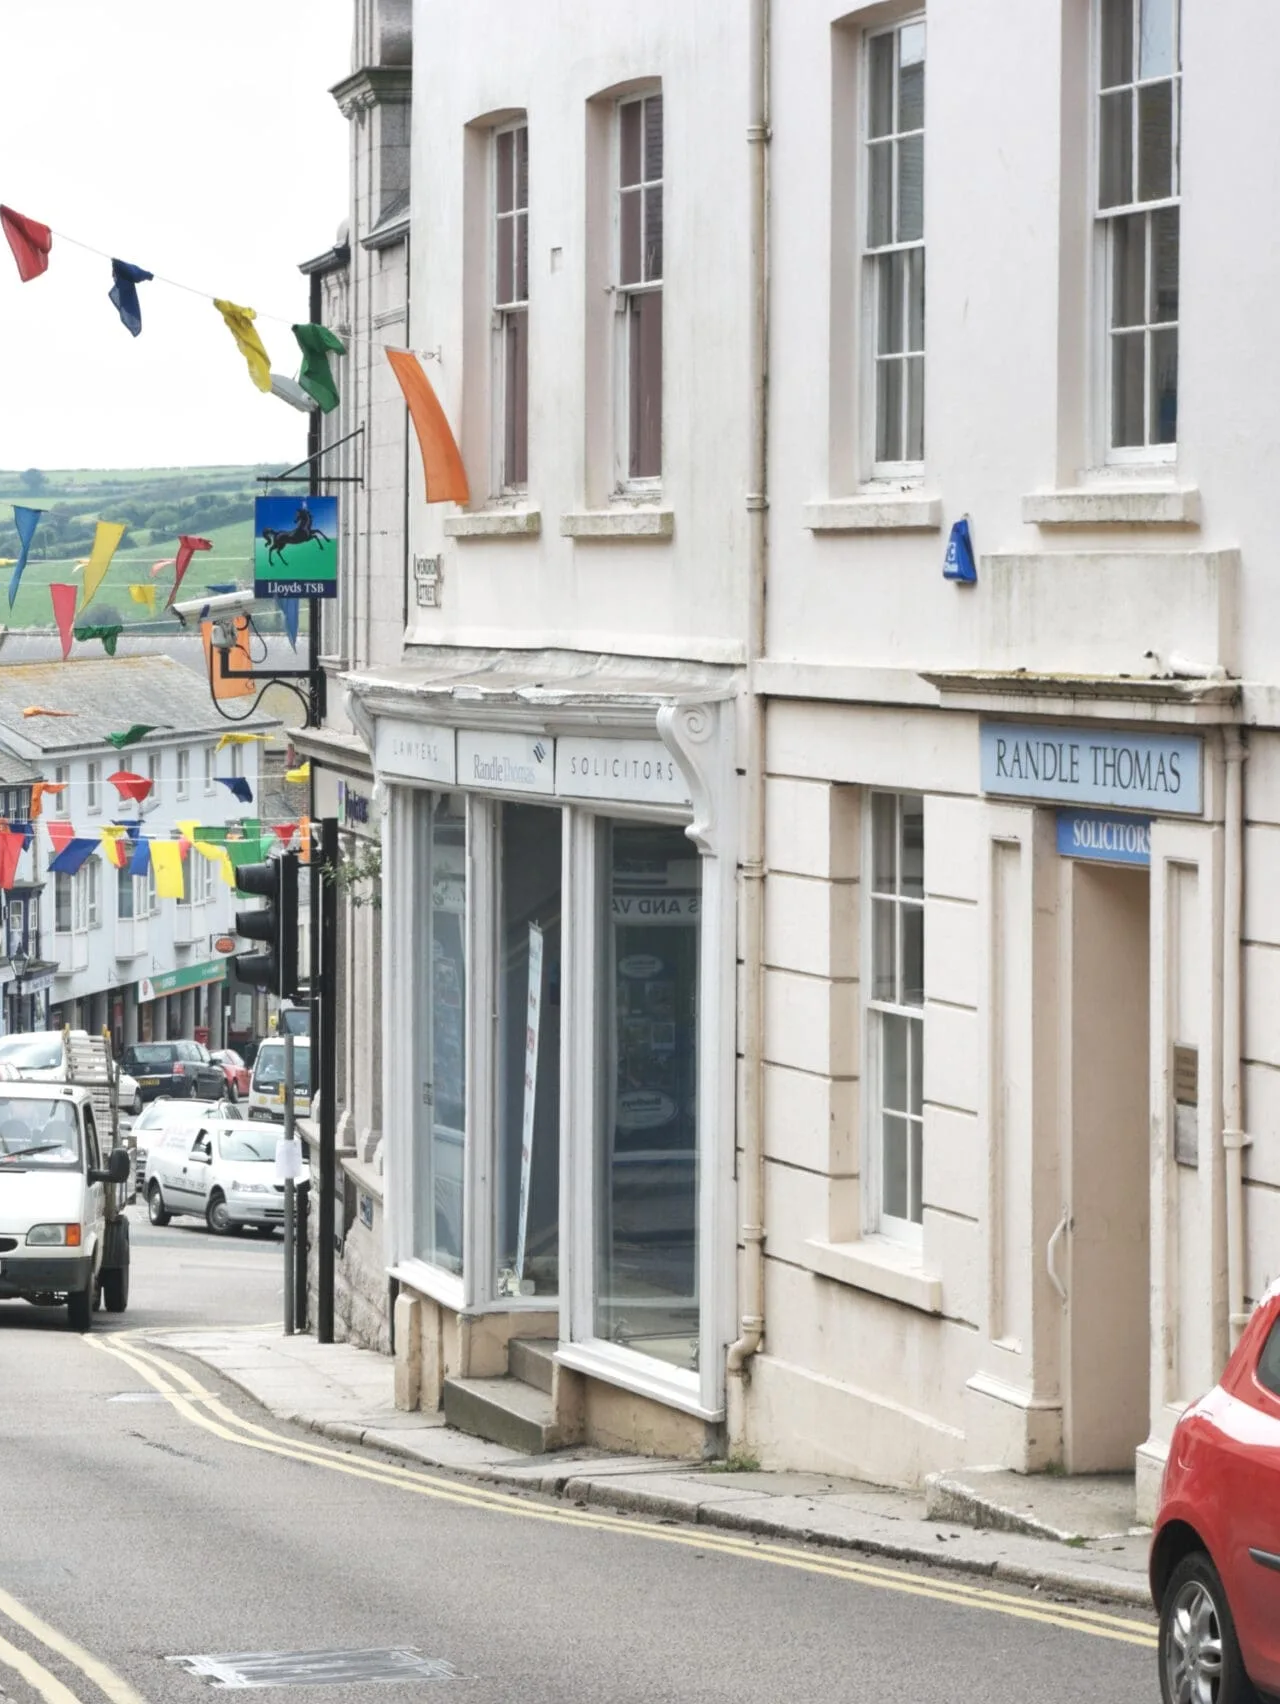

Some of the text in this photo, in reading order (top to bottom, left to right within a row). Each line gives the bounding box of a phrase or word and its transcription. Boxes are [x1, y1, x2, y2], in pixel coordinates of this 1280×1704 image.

[268, 582, 324, 597] Lloyds TSB
[393, 740, 438, 763] LAWYERS
[571, 757, 674, 782] SOLICITORS
[996, 739, 1181, 794] RANDLE THOMAS
